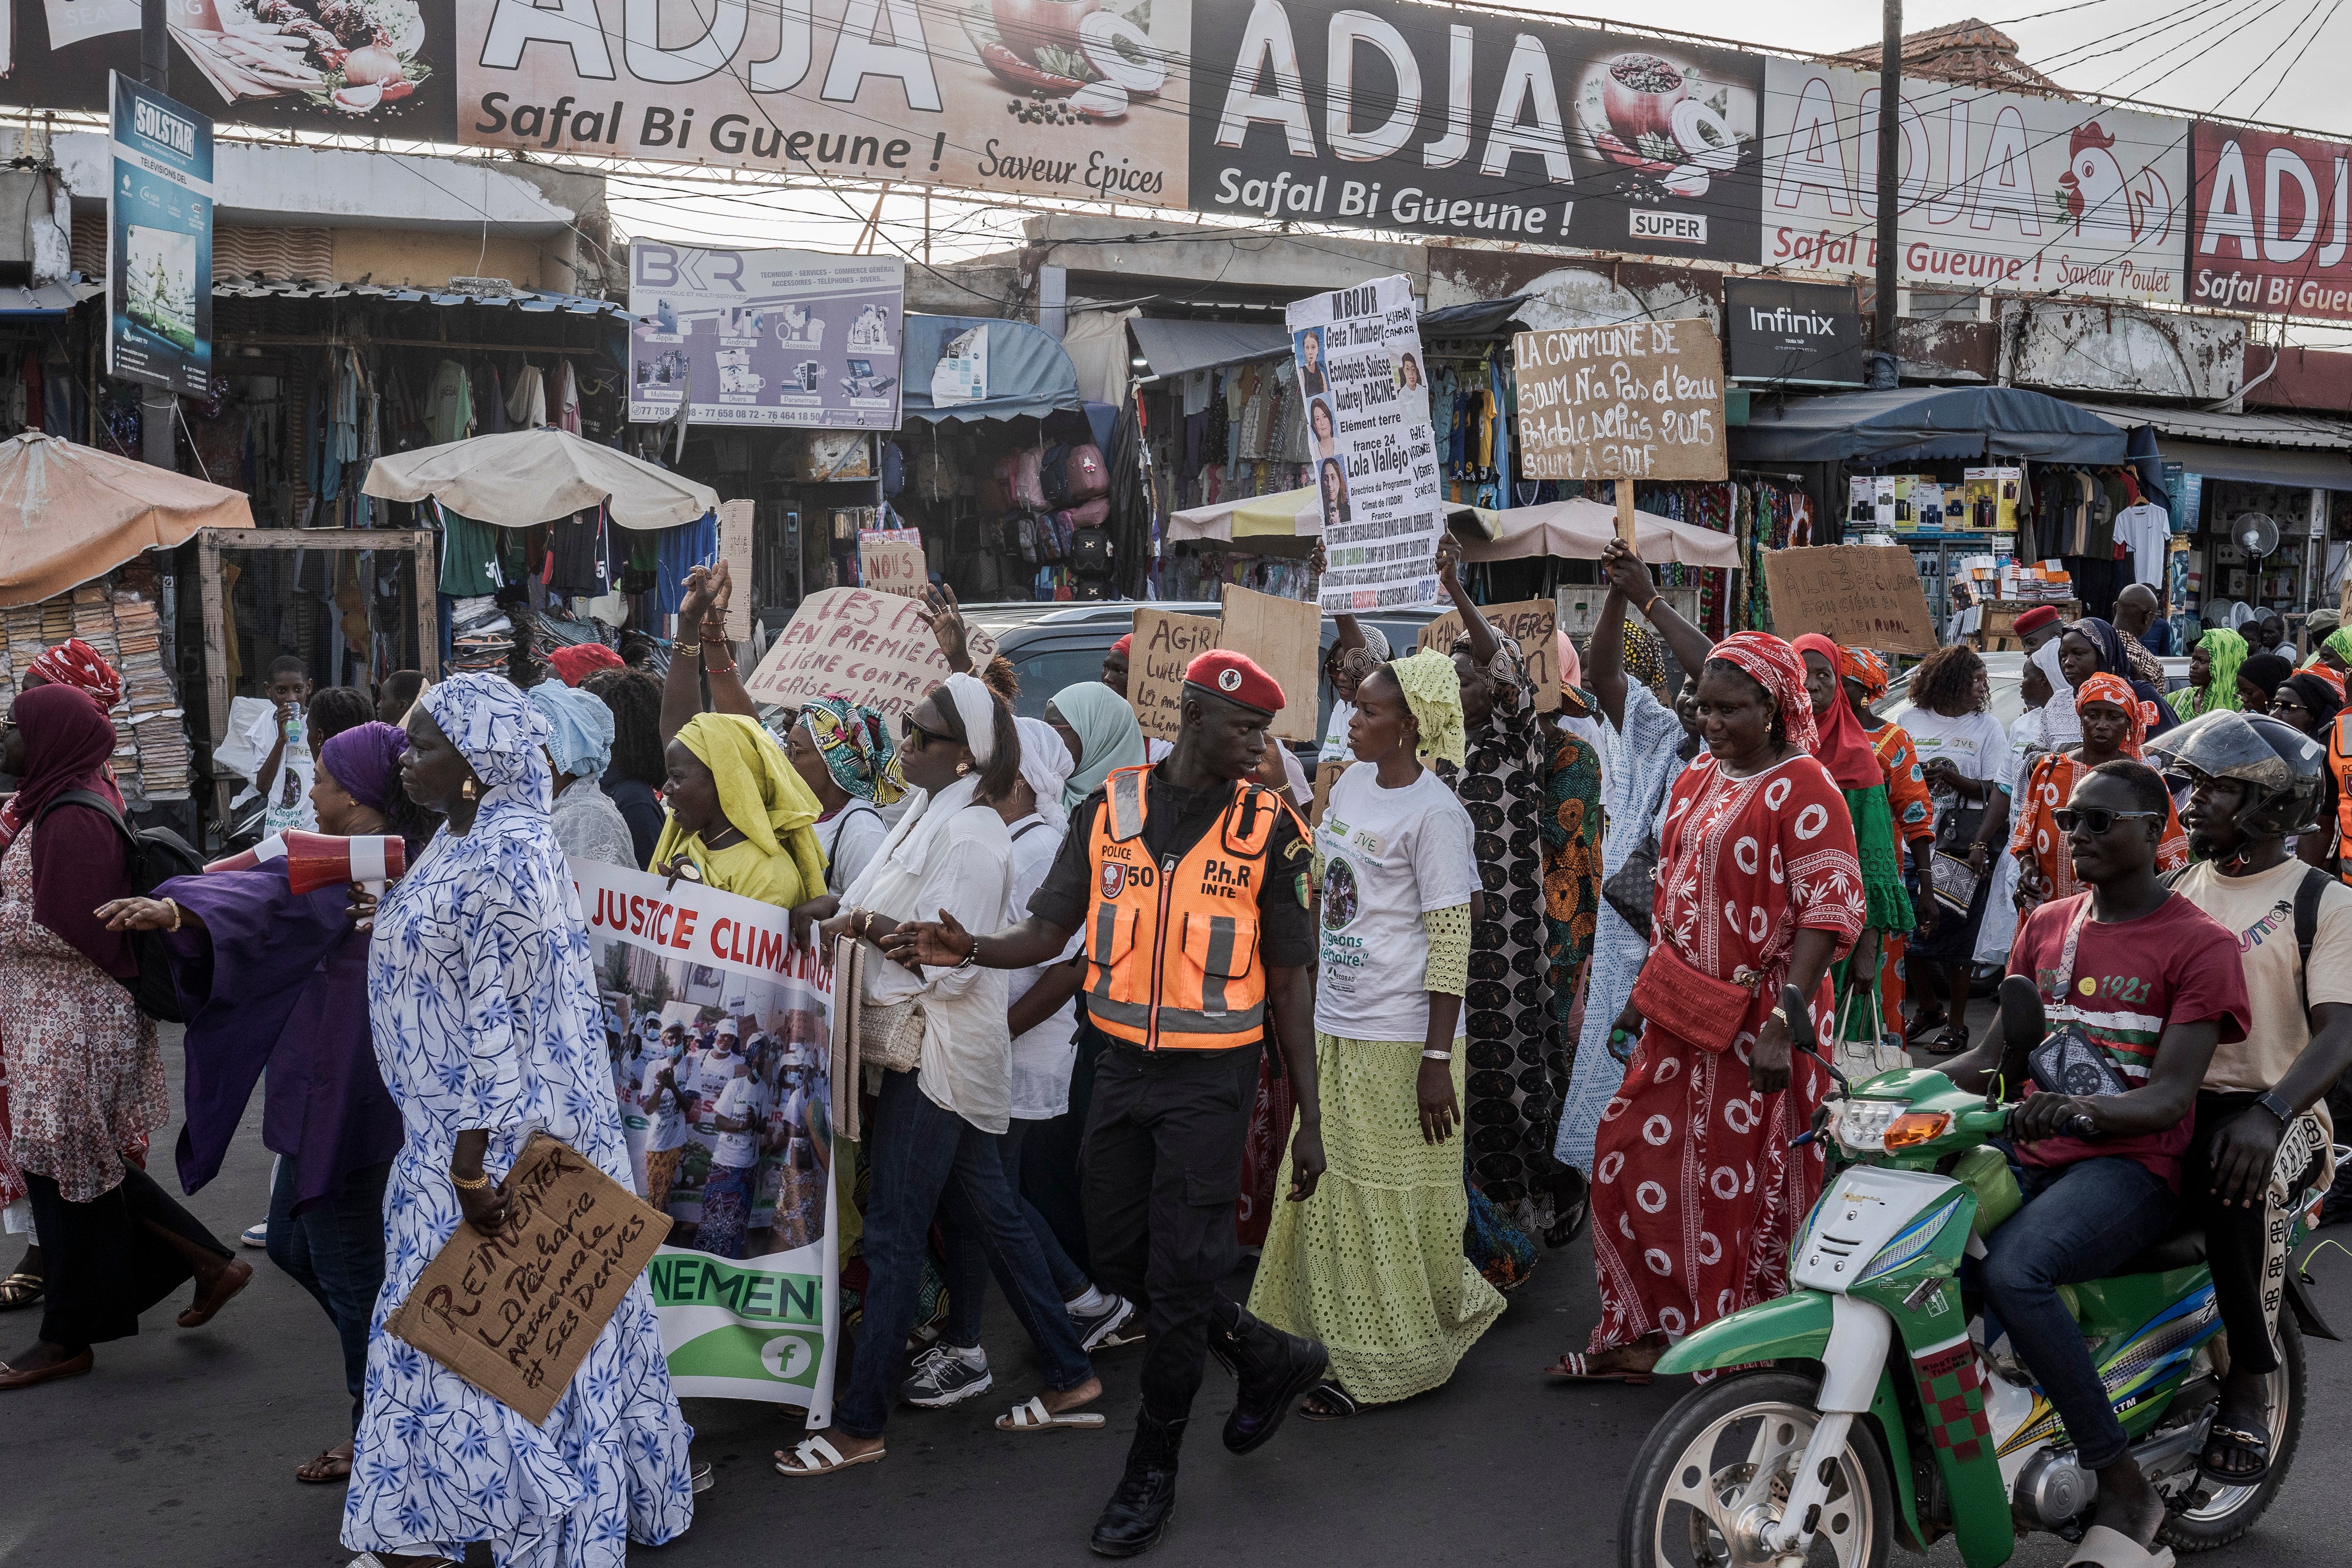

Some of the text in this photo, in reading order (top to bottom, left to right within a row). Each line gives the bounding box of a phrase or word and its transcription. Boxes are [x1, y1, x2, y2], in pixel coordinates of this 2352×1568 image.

[1214, 0, 1575, 186] ADJA
[136, 102, 193, 156] SOLSTAR
[475, 92, 946, 172] Safal Bi Gueune !
[1774, 77, 2042, 236] ADJA
[140, 156, 187, 185] TÉLÉVISIONS DEL
[978, 139, 1163, 199] Saveur Epices
[193, 204, 202, 212] USB
[1215, 168, 1573, 236] Safal Bi Gueune !
[2199, 139, 2352, 269] ADJ
[1635, 215, 1700, 238] SUPER
[1773, 227, 1857, 269] Safal
[1907, 242, 2023, 282] Gueune
[2032, 253, 2042, 282] !
[636, 244, 747, 292] BKR
[869, 265, 896, 273] GÉNÉRAL
[2057, 255, 2170, 293] Saveur Poulet
[772, 279, 812, 287] ACCESSOIRES
[817, 276, 854, 285] TÉLÉPHONES
[2195, 269, 2263, 307] Safal
[2267, 277, 2294, 306] Bi
[1332, 286, 1378, 321] MBOUR
[1385, 325, 1414, 339] CAMARA
[1750, 307, 1835, 336] Infinix
[656, 333, 674, 343] Apple
[726, 337, 750, 346] Android
[785, 340, 820, 350] Accessoires
[848, 343, 873, 352] Coques
[1326, 326, 1347, 350] Greta
[1518, 323, 1680, 370] LA COMMUNE DE
[1328, 354, 1392, 385] Ecologiste Suisse
[1335, 377, 1396, 413] Audrey RACINE
[1519, 374, 1572, 414] SOUM
[1609, 360, 1649, 402] Pas
[1652, 364, 1718, 404] d'eau
[784, 396, 818, 404] Parametrage
[641, 406, 820, 420] 77 758 77 658 08 72 76 464 18 50
[1339, 413, 1401, 433] Elément terre
[1353, 433, 1395, 452] france 24
[1521, 408, 1715, 453] Potable 2015
[1347, 445, 1408, 478] Lola Vallejo
[1412, 463, 1435, 482] VERTES
[1522, 453, 1574, 479] SOUM
[1601, 444, 1658, 477] SOIF
[1351, 478, 1412, 497] Directrice du Programme
[1362, 499, 1378, 511] Climat
[1378, 497, 1385, 508] de
[1371, 511, 1392, 521] France
[1333, 526, 1349, 544] FEMMES
[1350, 522, 1378, 543] SENEGALAISES
[1384, 519, 1399, 538] MONDE
[1399, 516, 1413, 535] RURAL
[1414, 512, 1434, 532] DERRIERE
[1331, 537, 1430, 567] KHADY CAMARA SUR VOTRE SOUTIENT
[1829, 546, 1881, 575] STOP
[869, 552, 914, 581] NOUS
[1385, 563, 1402, 581] JUSTICE
[1402, 559, 1428, 580] CLIMATIQUE
[1801, 570, 1834, 594] LA
[1344, 579, 1436, 610] DES RESULTATS SATISFAISANTS LA COP29
[1882, 596, 1898, 610] EN
[817, 590, 885, 627] LES
[781, 618, 823, 646] EN
[1875, 618, 1910, 634] RURAL
[750, 672, 774, 690] LA
[293, 747, 310, 756] JVE
[1954, 740, 1974, 748] JVE
[1102, 845, 1132, 861] POLICE
[1354, 833, 1377, 852] JVE
[1350, 850, 1359, 858] pour
[1364, 857, 1383, 868] Climat
[1128, 866, 1154, 887] 50
[591, 887, 699, 950] JUSTICE
[1336, 974, 1355, 982] ECOBAD
[2099, 974, 2152, 1005] 1921
[649, 1259, 823, 1320] NEMEN
[1922, 1350, 1970, 1372] KingTown
[1931, 1360, 1967, 1376] TianMa
